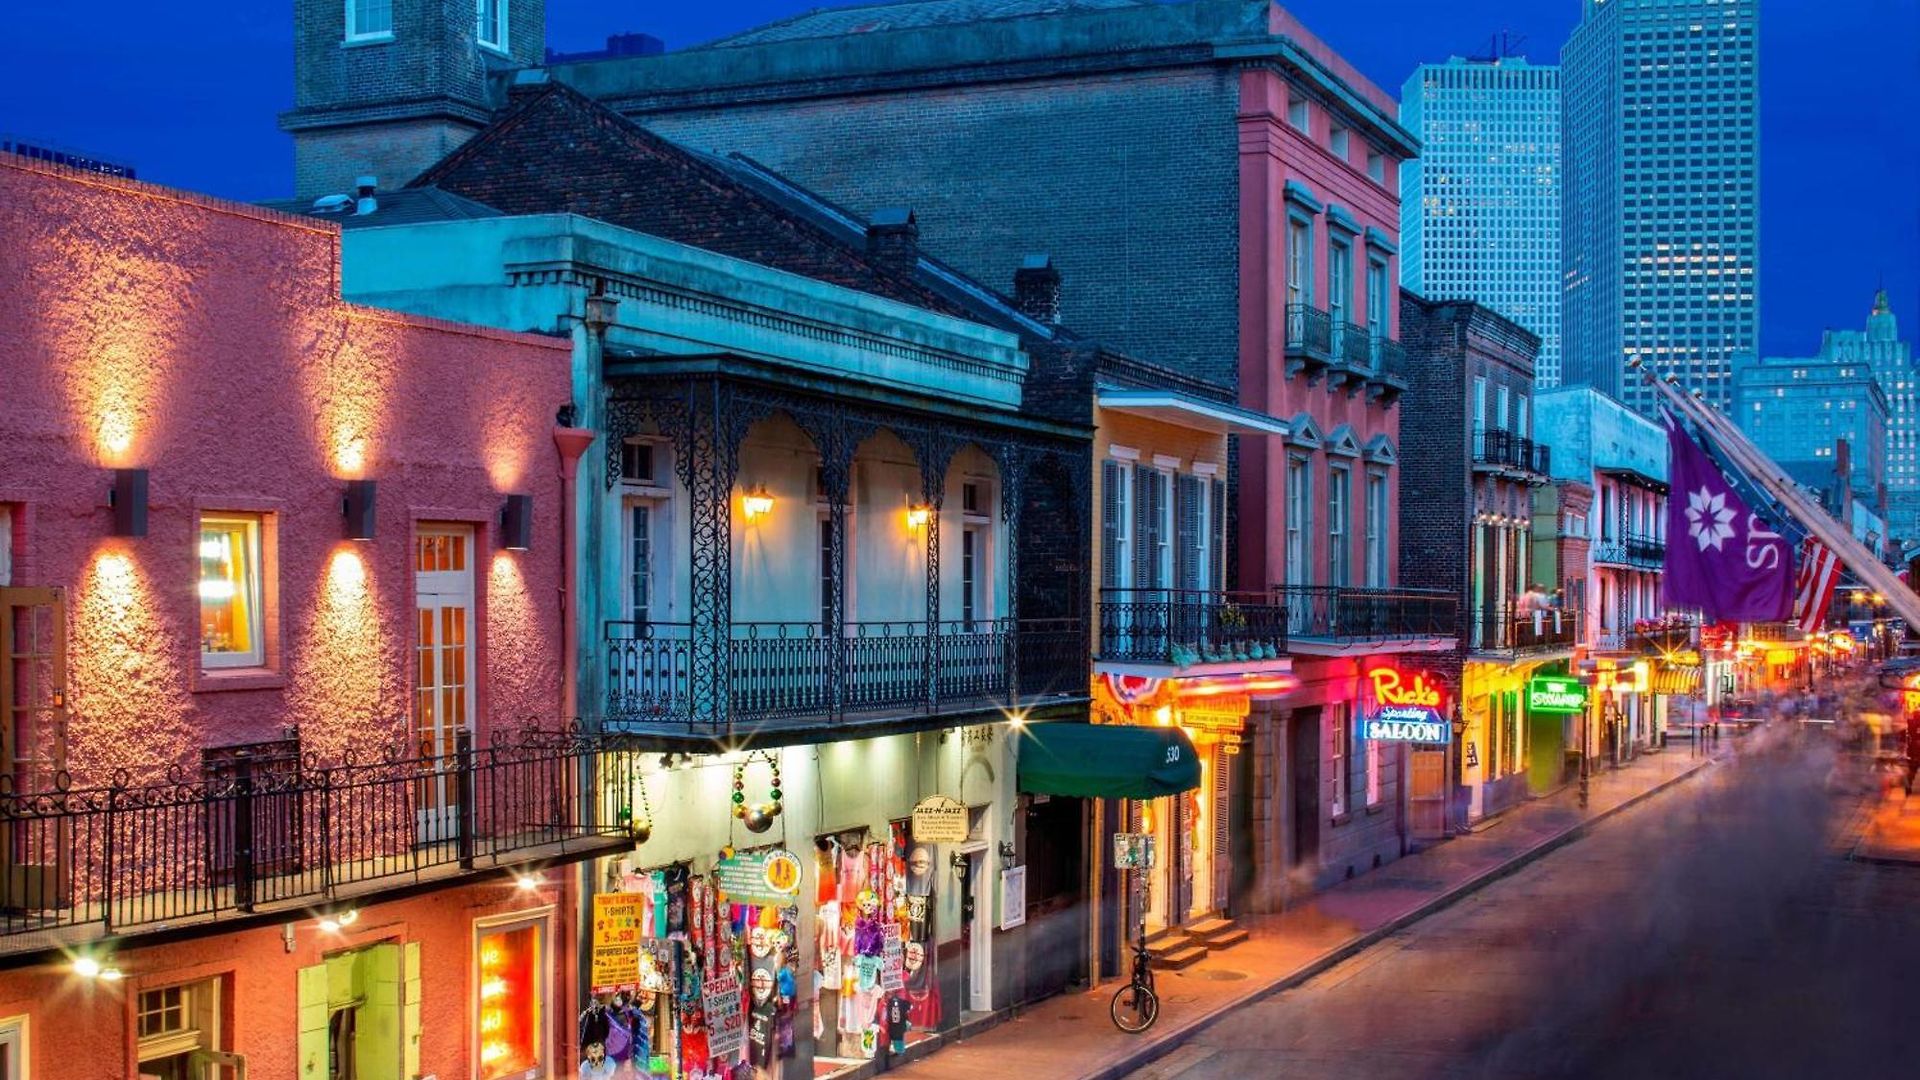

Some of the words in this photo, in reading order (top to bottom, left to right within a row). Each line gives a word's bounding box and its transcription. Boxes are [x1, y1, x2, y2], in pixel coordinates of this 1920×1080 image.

[1369, 667, 1440, 706] Rick's
[1381, 706, 1428, 722] Sporting
[1369, 722, 1440, 740] SALOON
[604, 905, 635, 917] T-SHIRTS
[618, 929, 635, 942] $20
[708, 991, 738, 1008] T-SHIRTS
[723, 1013, 740, 1031] $20
